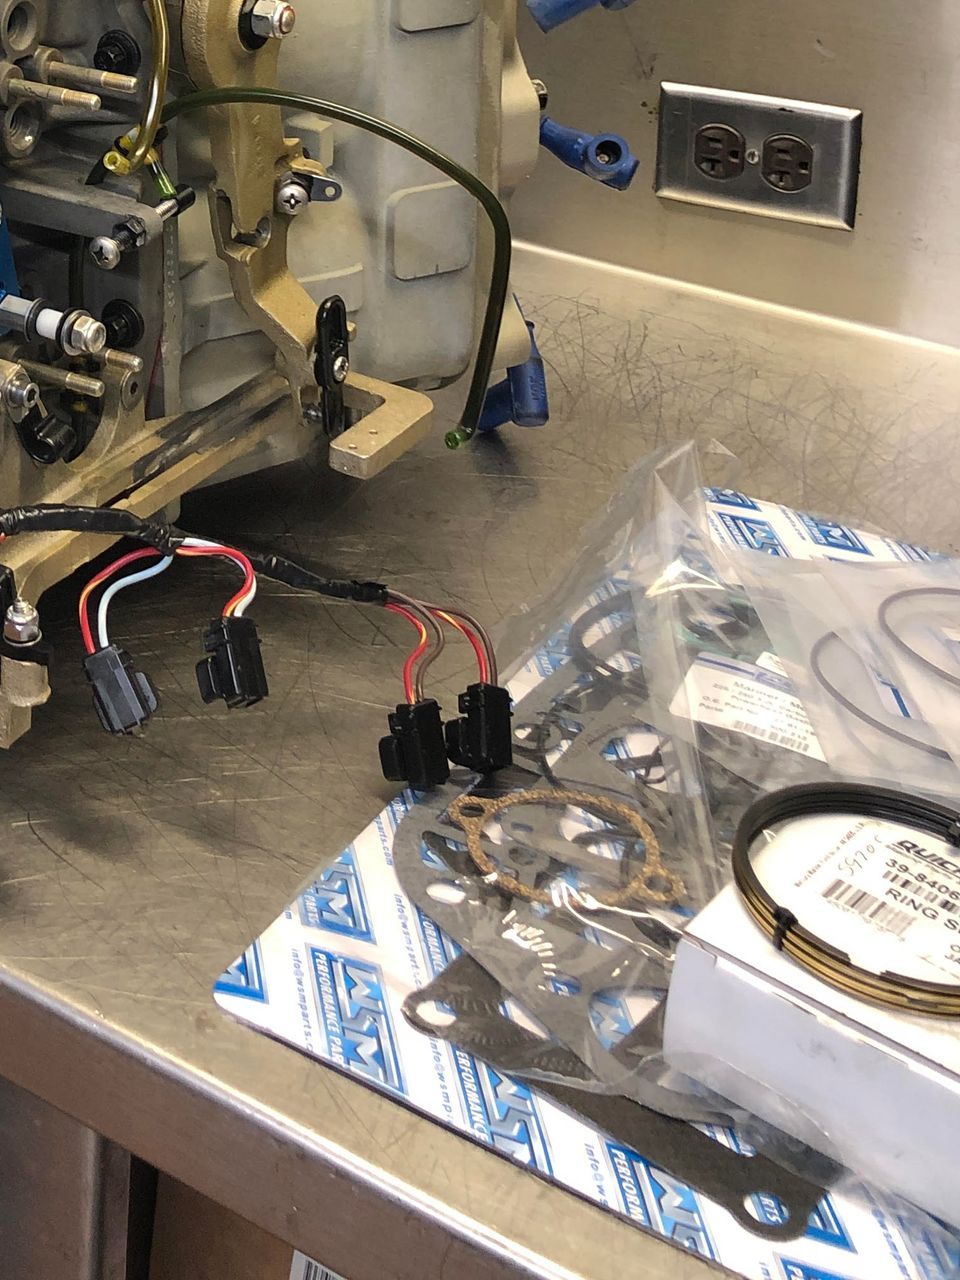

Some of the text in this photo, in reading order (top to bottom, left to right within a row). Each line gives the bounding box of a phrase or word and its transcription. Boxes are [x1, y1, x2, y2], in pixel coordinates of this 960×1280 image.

[885, 888, 940, 920] RING
[314, 951, 340, 1035] PERFORMANCE
[456, 1048, 490, 1141] ERFORMANCE
[760, 1196, 783, 1225] RTS
